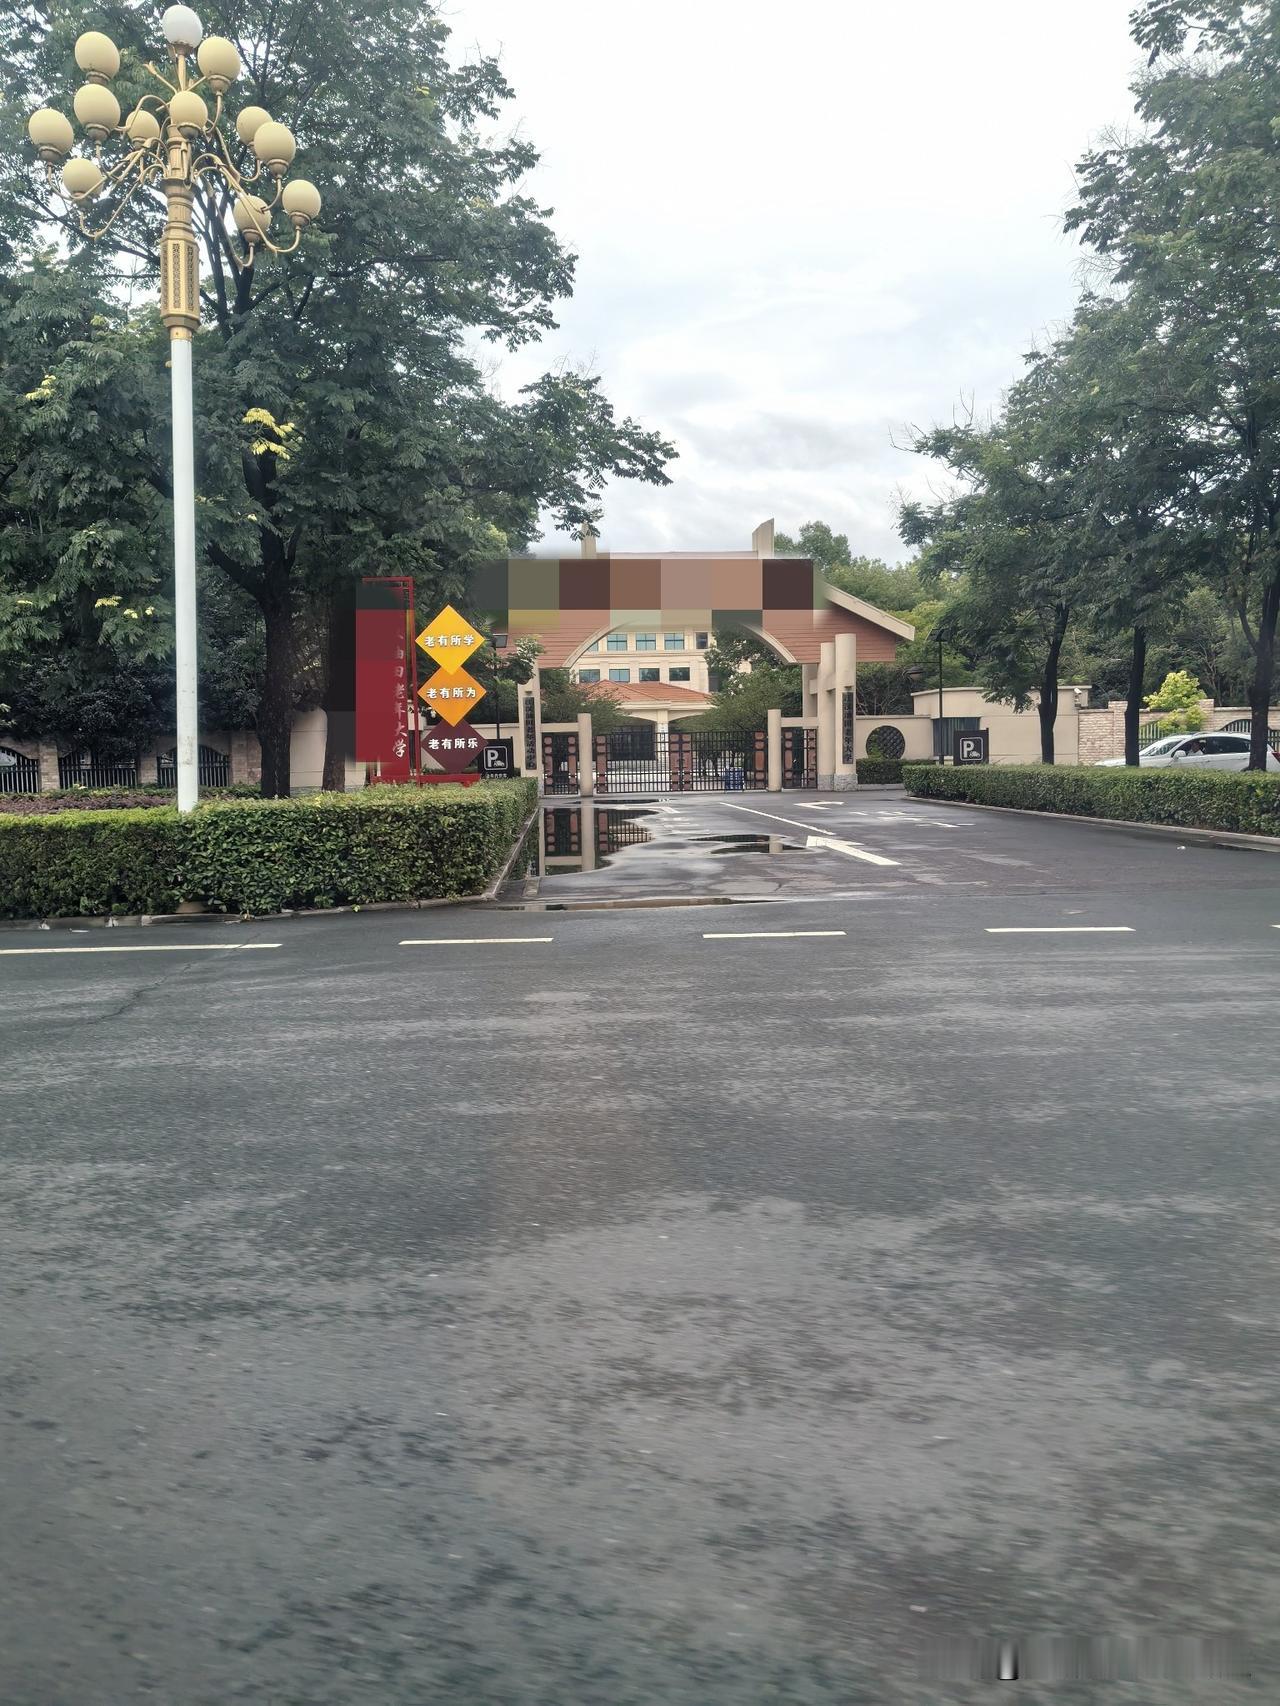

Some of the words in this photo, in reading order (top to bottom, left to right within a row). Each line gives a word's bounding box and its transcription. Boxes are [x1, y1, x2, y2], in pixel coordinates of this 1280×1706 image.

[424, 634, 474, 647] 老有所学
[427, 687, 476, 699] 老有所为
[428, 737, 478, 750] 老有所乐
[963, 740, 975, 758] P
[487, 749, 499, 768] P
